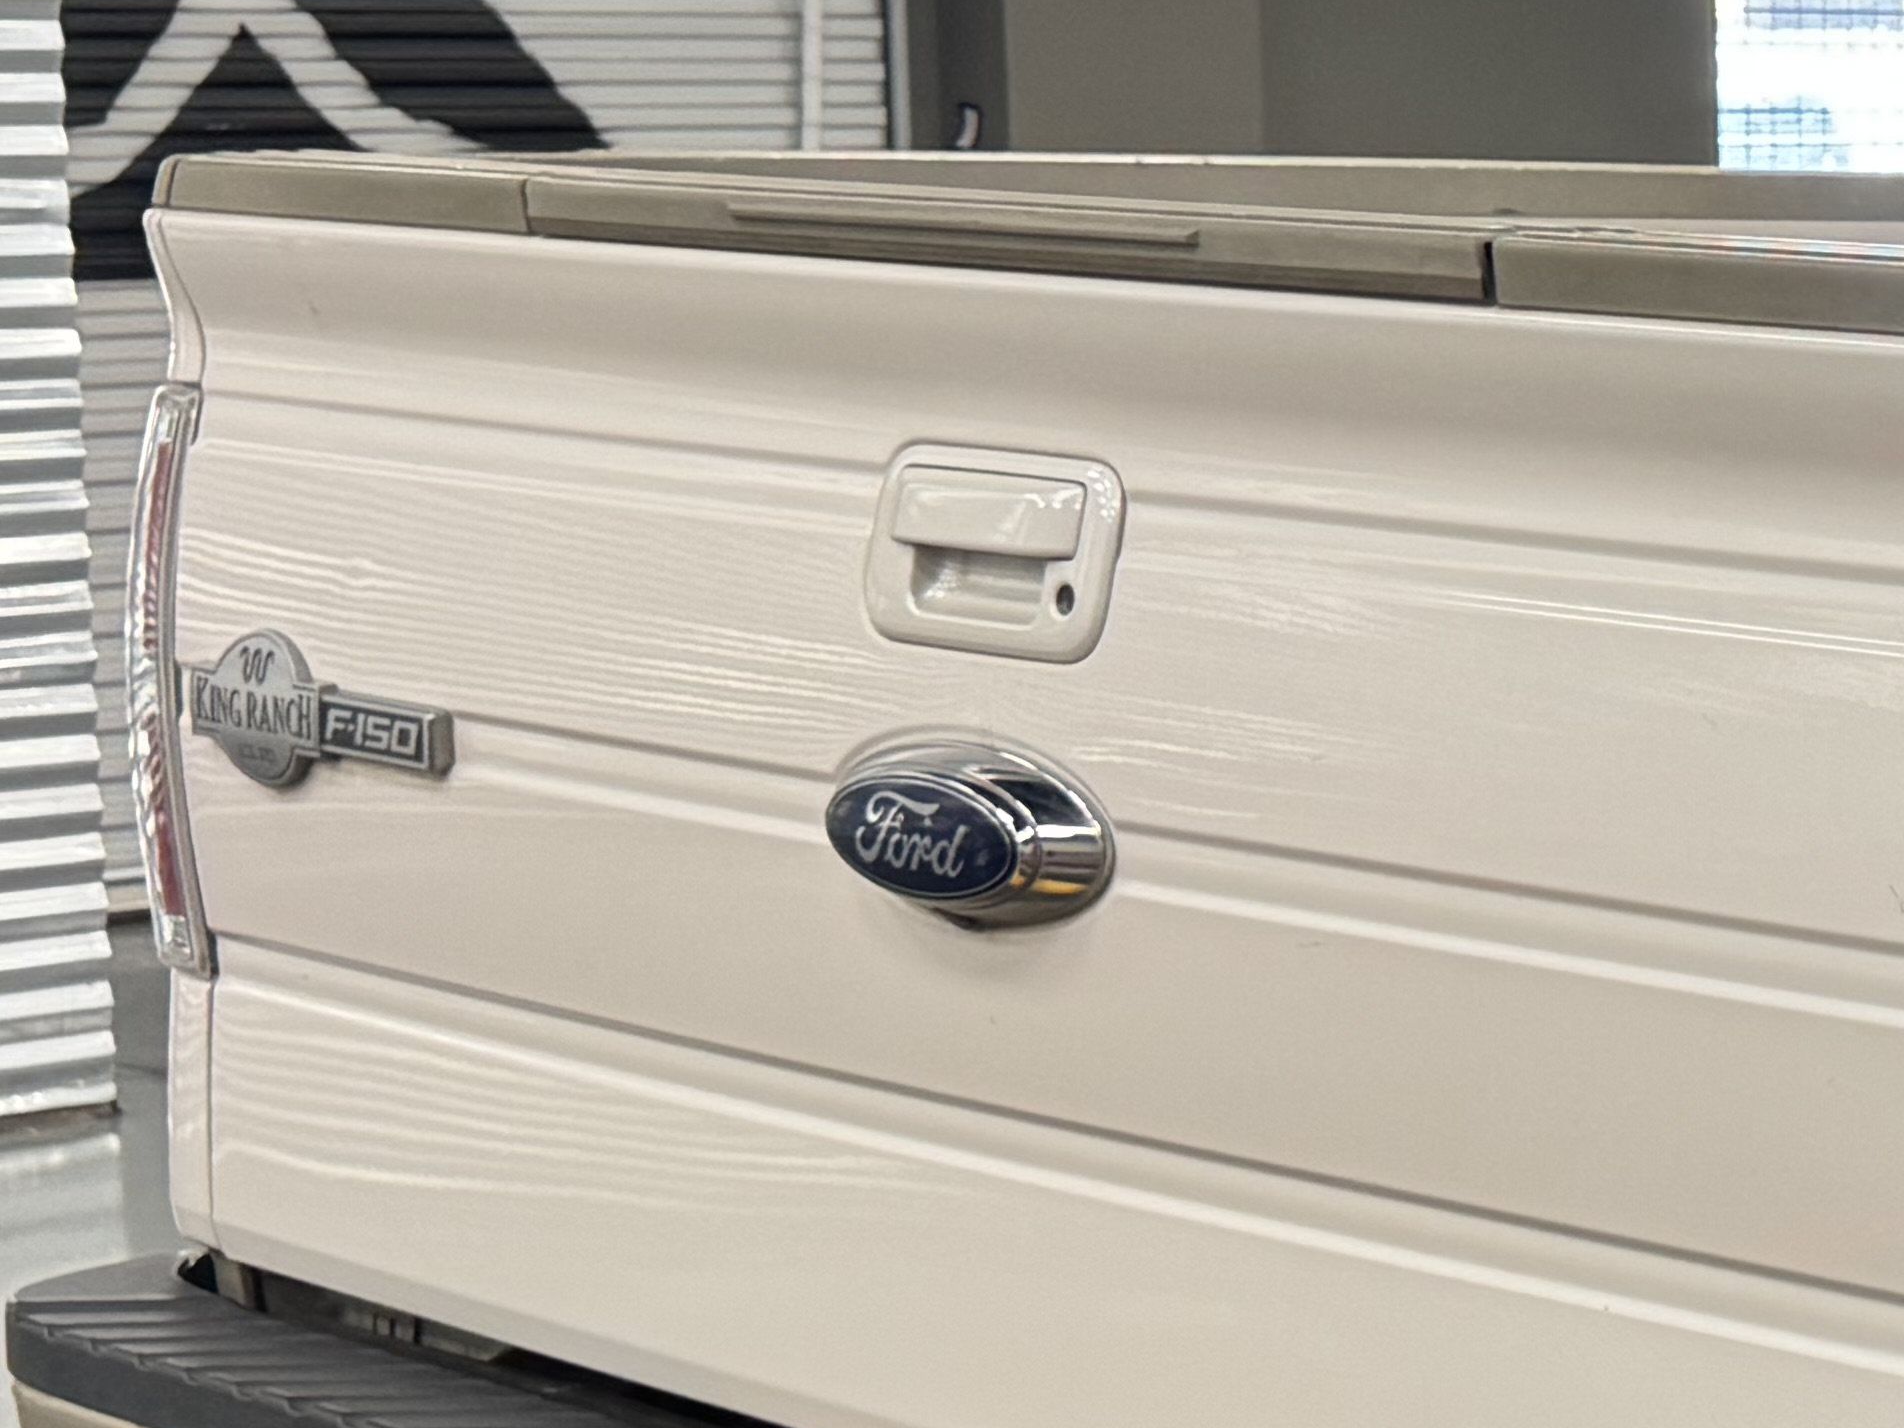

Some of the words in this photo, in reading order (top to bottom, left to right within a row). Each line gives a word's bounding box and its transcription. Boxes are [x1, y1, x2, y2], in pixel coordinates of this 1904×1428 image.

[194, 675, 242, 728] KING
[246, 687, 312, 740] RANCH
[323, 707, 419, 756] F-150
[854, 789, 972, 878] Ford
